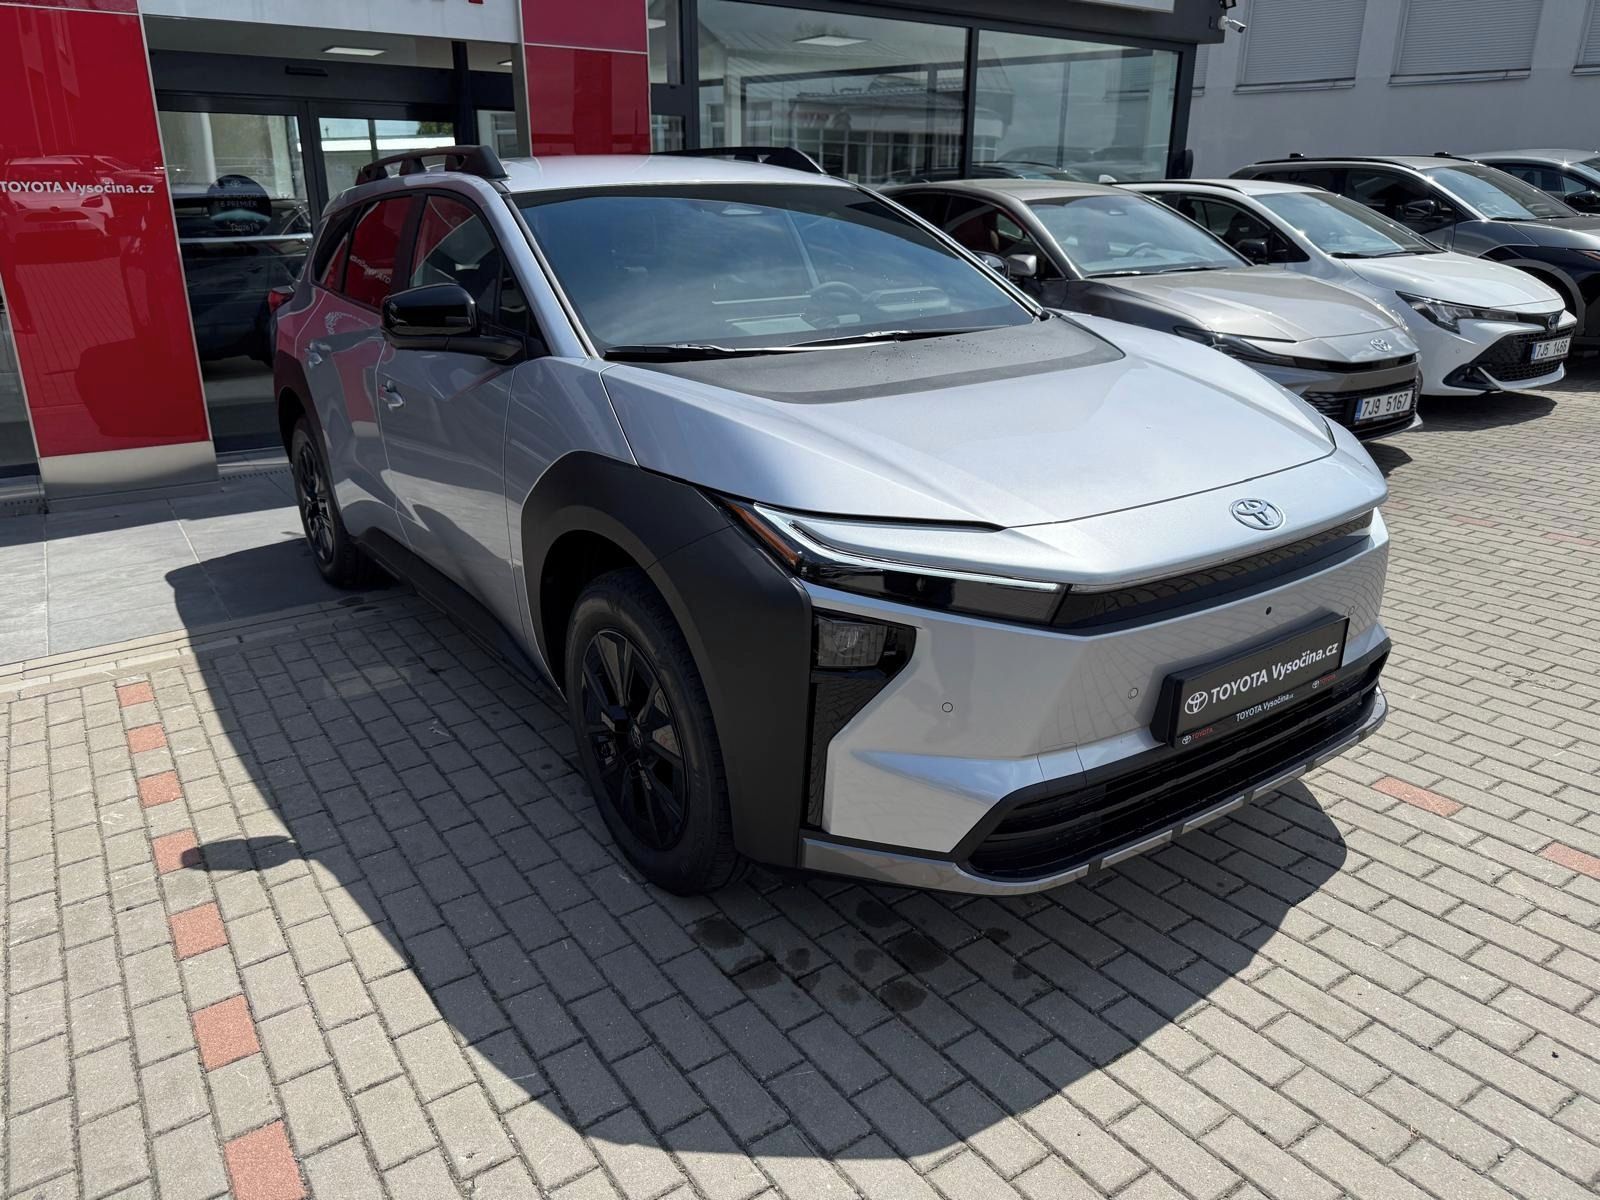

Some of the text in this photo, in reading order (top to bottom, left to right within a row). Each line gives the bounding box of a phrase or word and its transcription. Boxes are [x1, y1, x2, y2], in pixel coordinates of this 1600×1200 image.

[0, 180, 155, 196] TOYOTA Vysočina.cz
[1535, 343, 1550, 358] 7J5
[1362, 393, 1409, 417] 7J9 5167
[1211, 643, 1339, 704] TOYOTA Vysočina.cz
[1235, 703, 1262, 722] TOYOTA
[1191, 727, 1213, 741] TOYOTA
